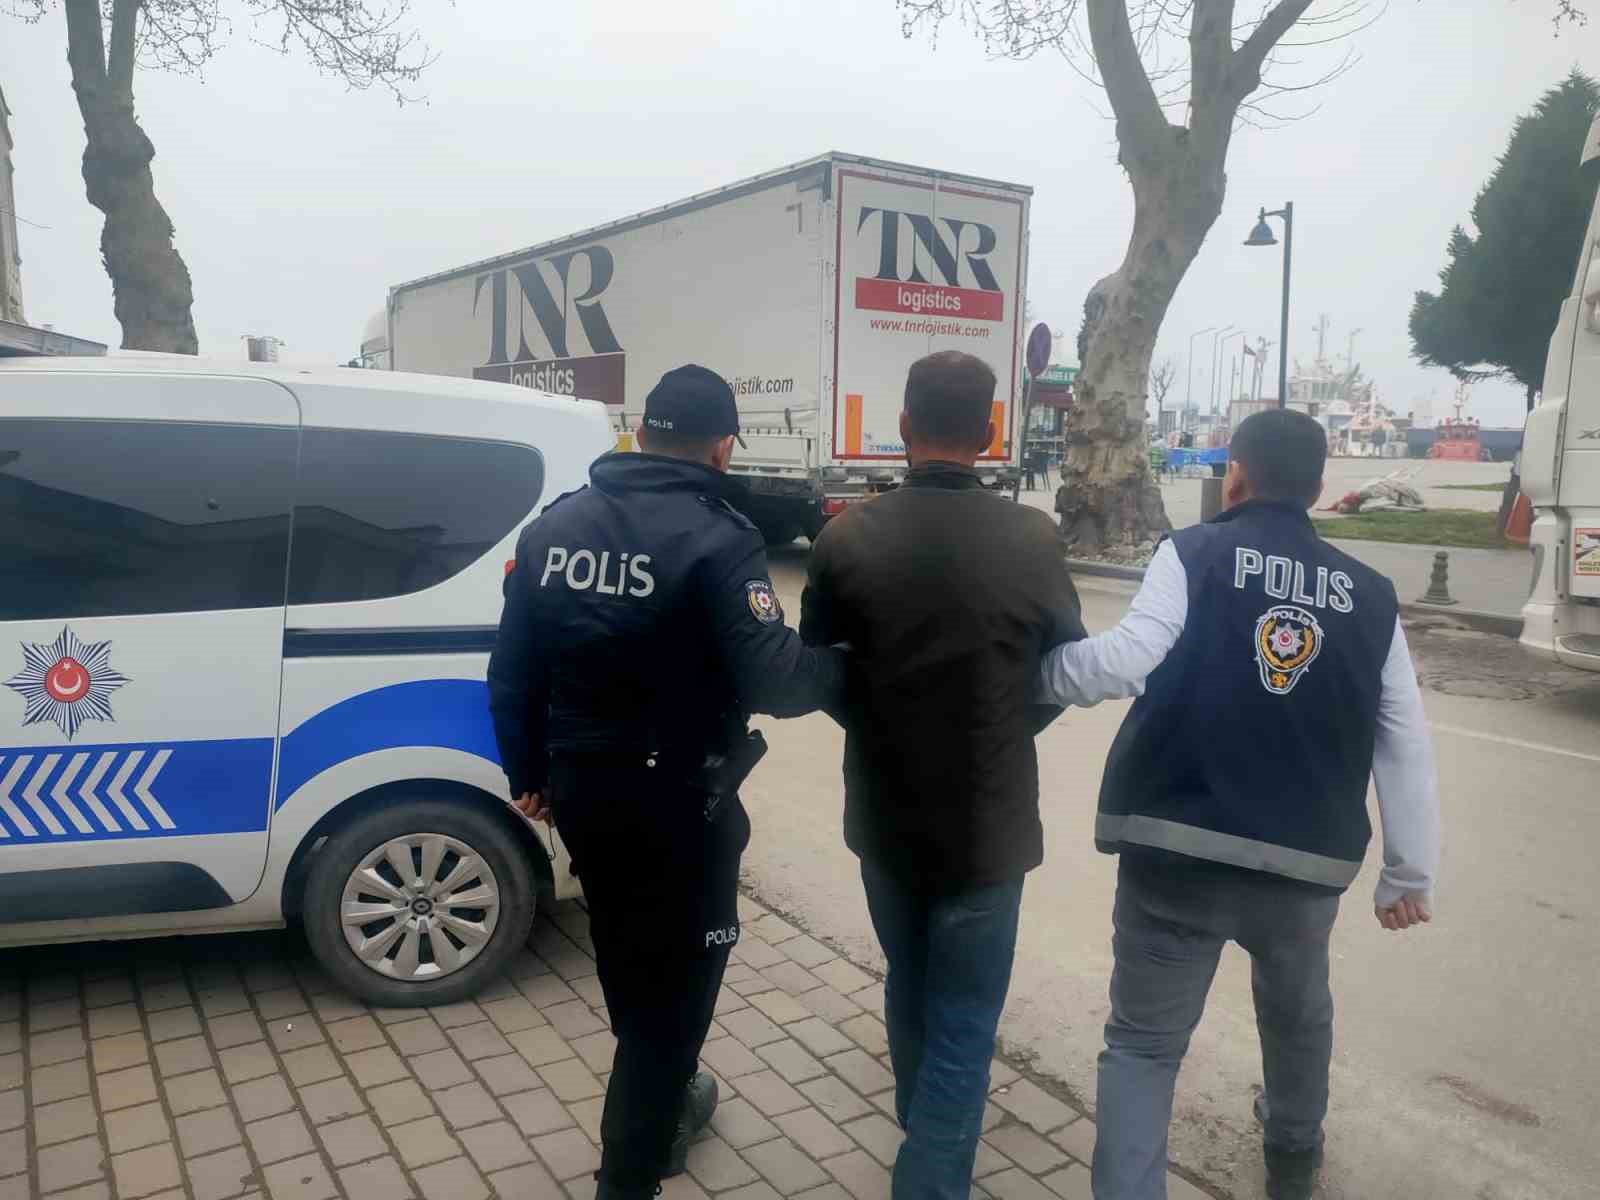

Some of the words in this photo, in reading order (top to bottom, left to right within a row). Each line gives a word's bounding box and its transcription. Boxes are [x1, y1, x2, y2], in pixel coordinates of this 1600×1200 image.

[857, 207, 1000, 291] TNR
[472, 245, 624, 364] TNR
[898, 287, 961, 312] logistics
[870, 319, 989, 338] www.tnrlojistik.com
